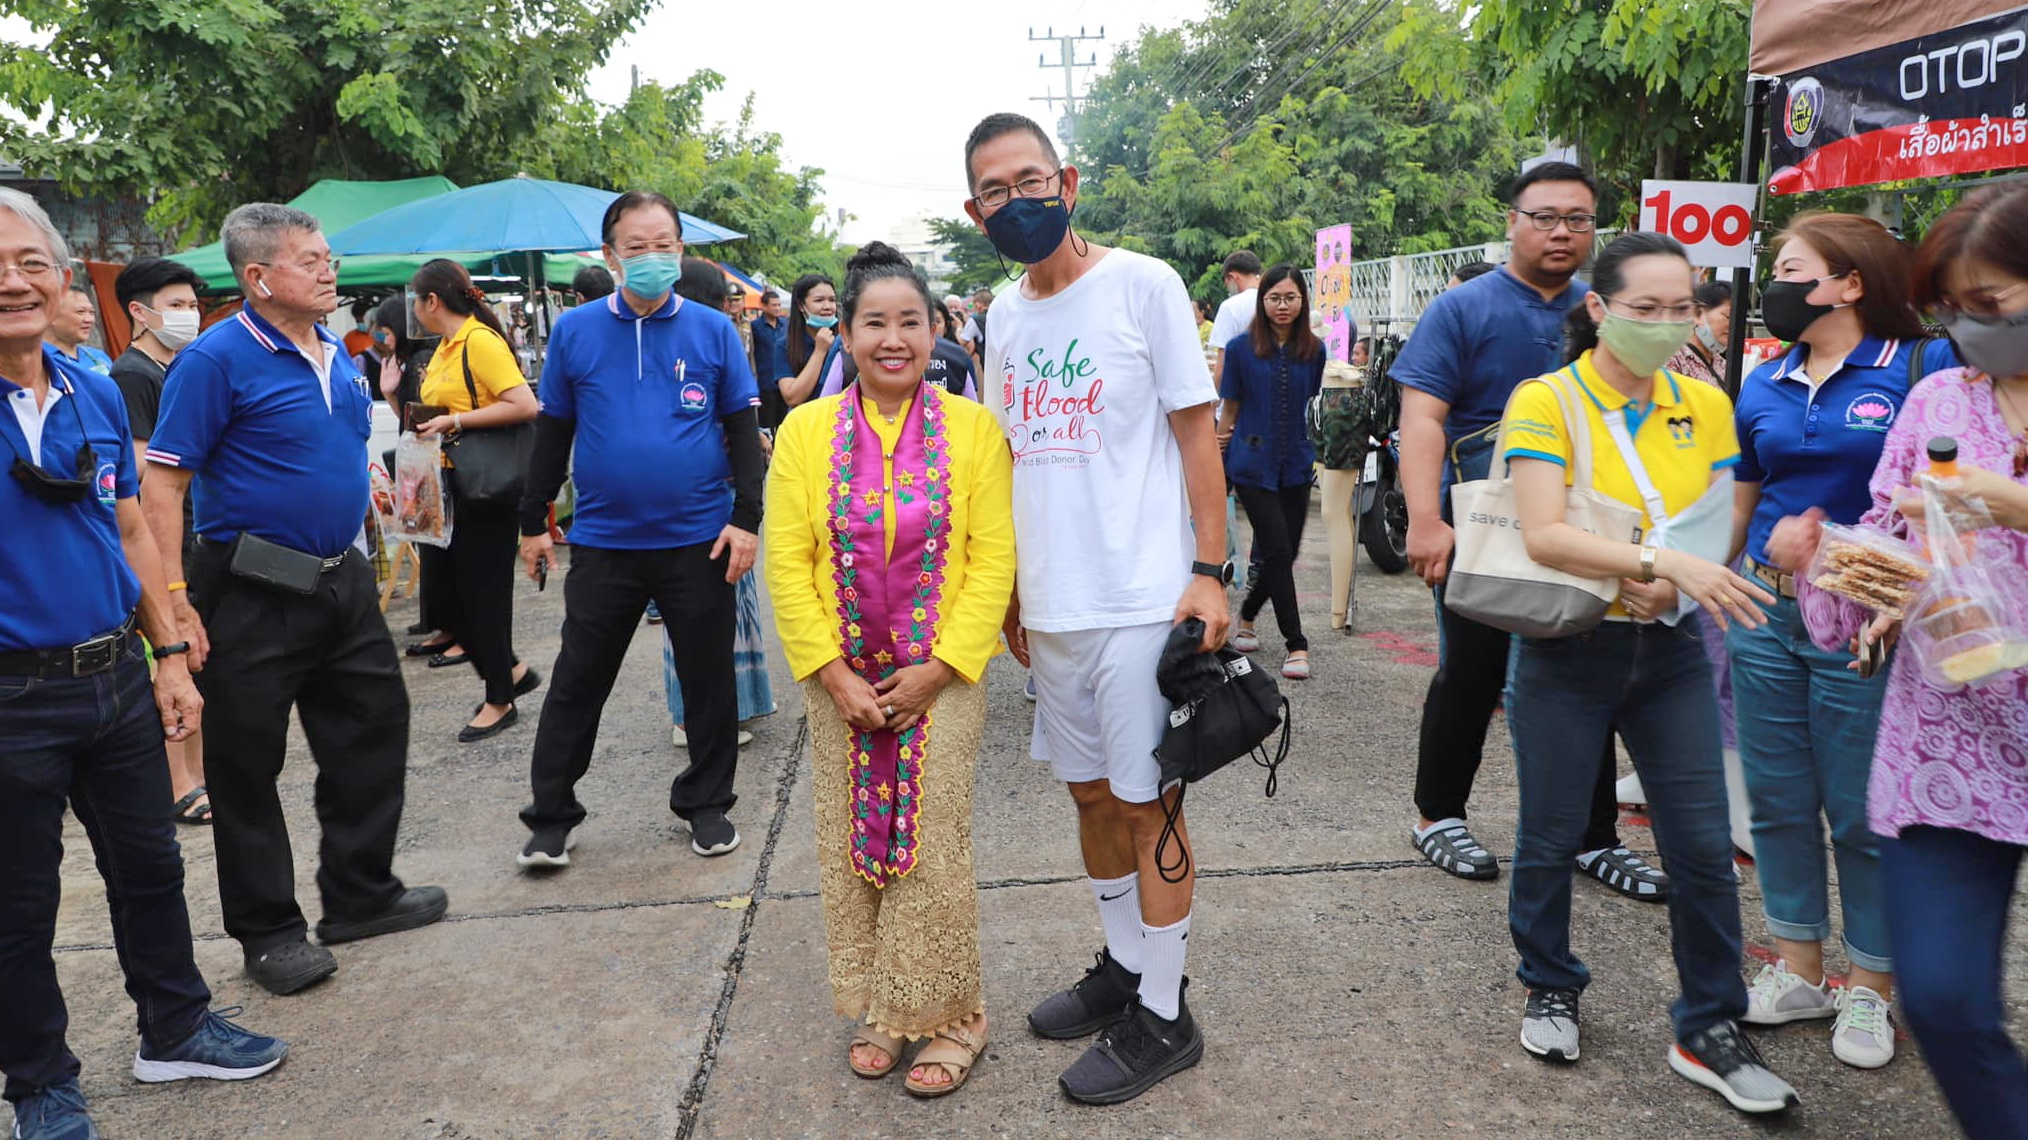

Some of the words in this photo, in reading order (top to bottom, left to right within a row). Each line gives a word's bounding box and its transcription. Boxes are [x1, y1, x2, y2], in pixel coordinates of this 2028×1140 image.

[1900, 30, 2025, 101] OTOP
[1645, 190, 1752, 247] 100
[1025, 339, 1097, 388] Safe
[1053, 416, 1085, 440] all
[1051, 455, 1076, 464] Donor
[1469, 512, 1508, 528] save
